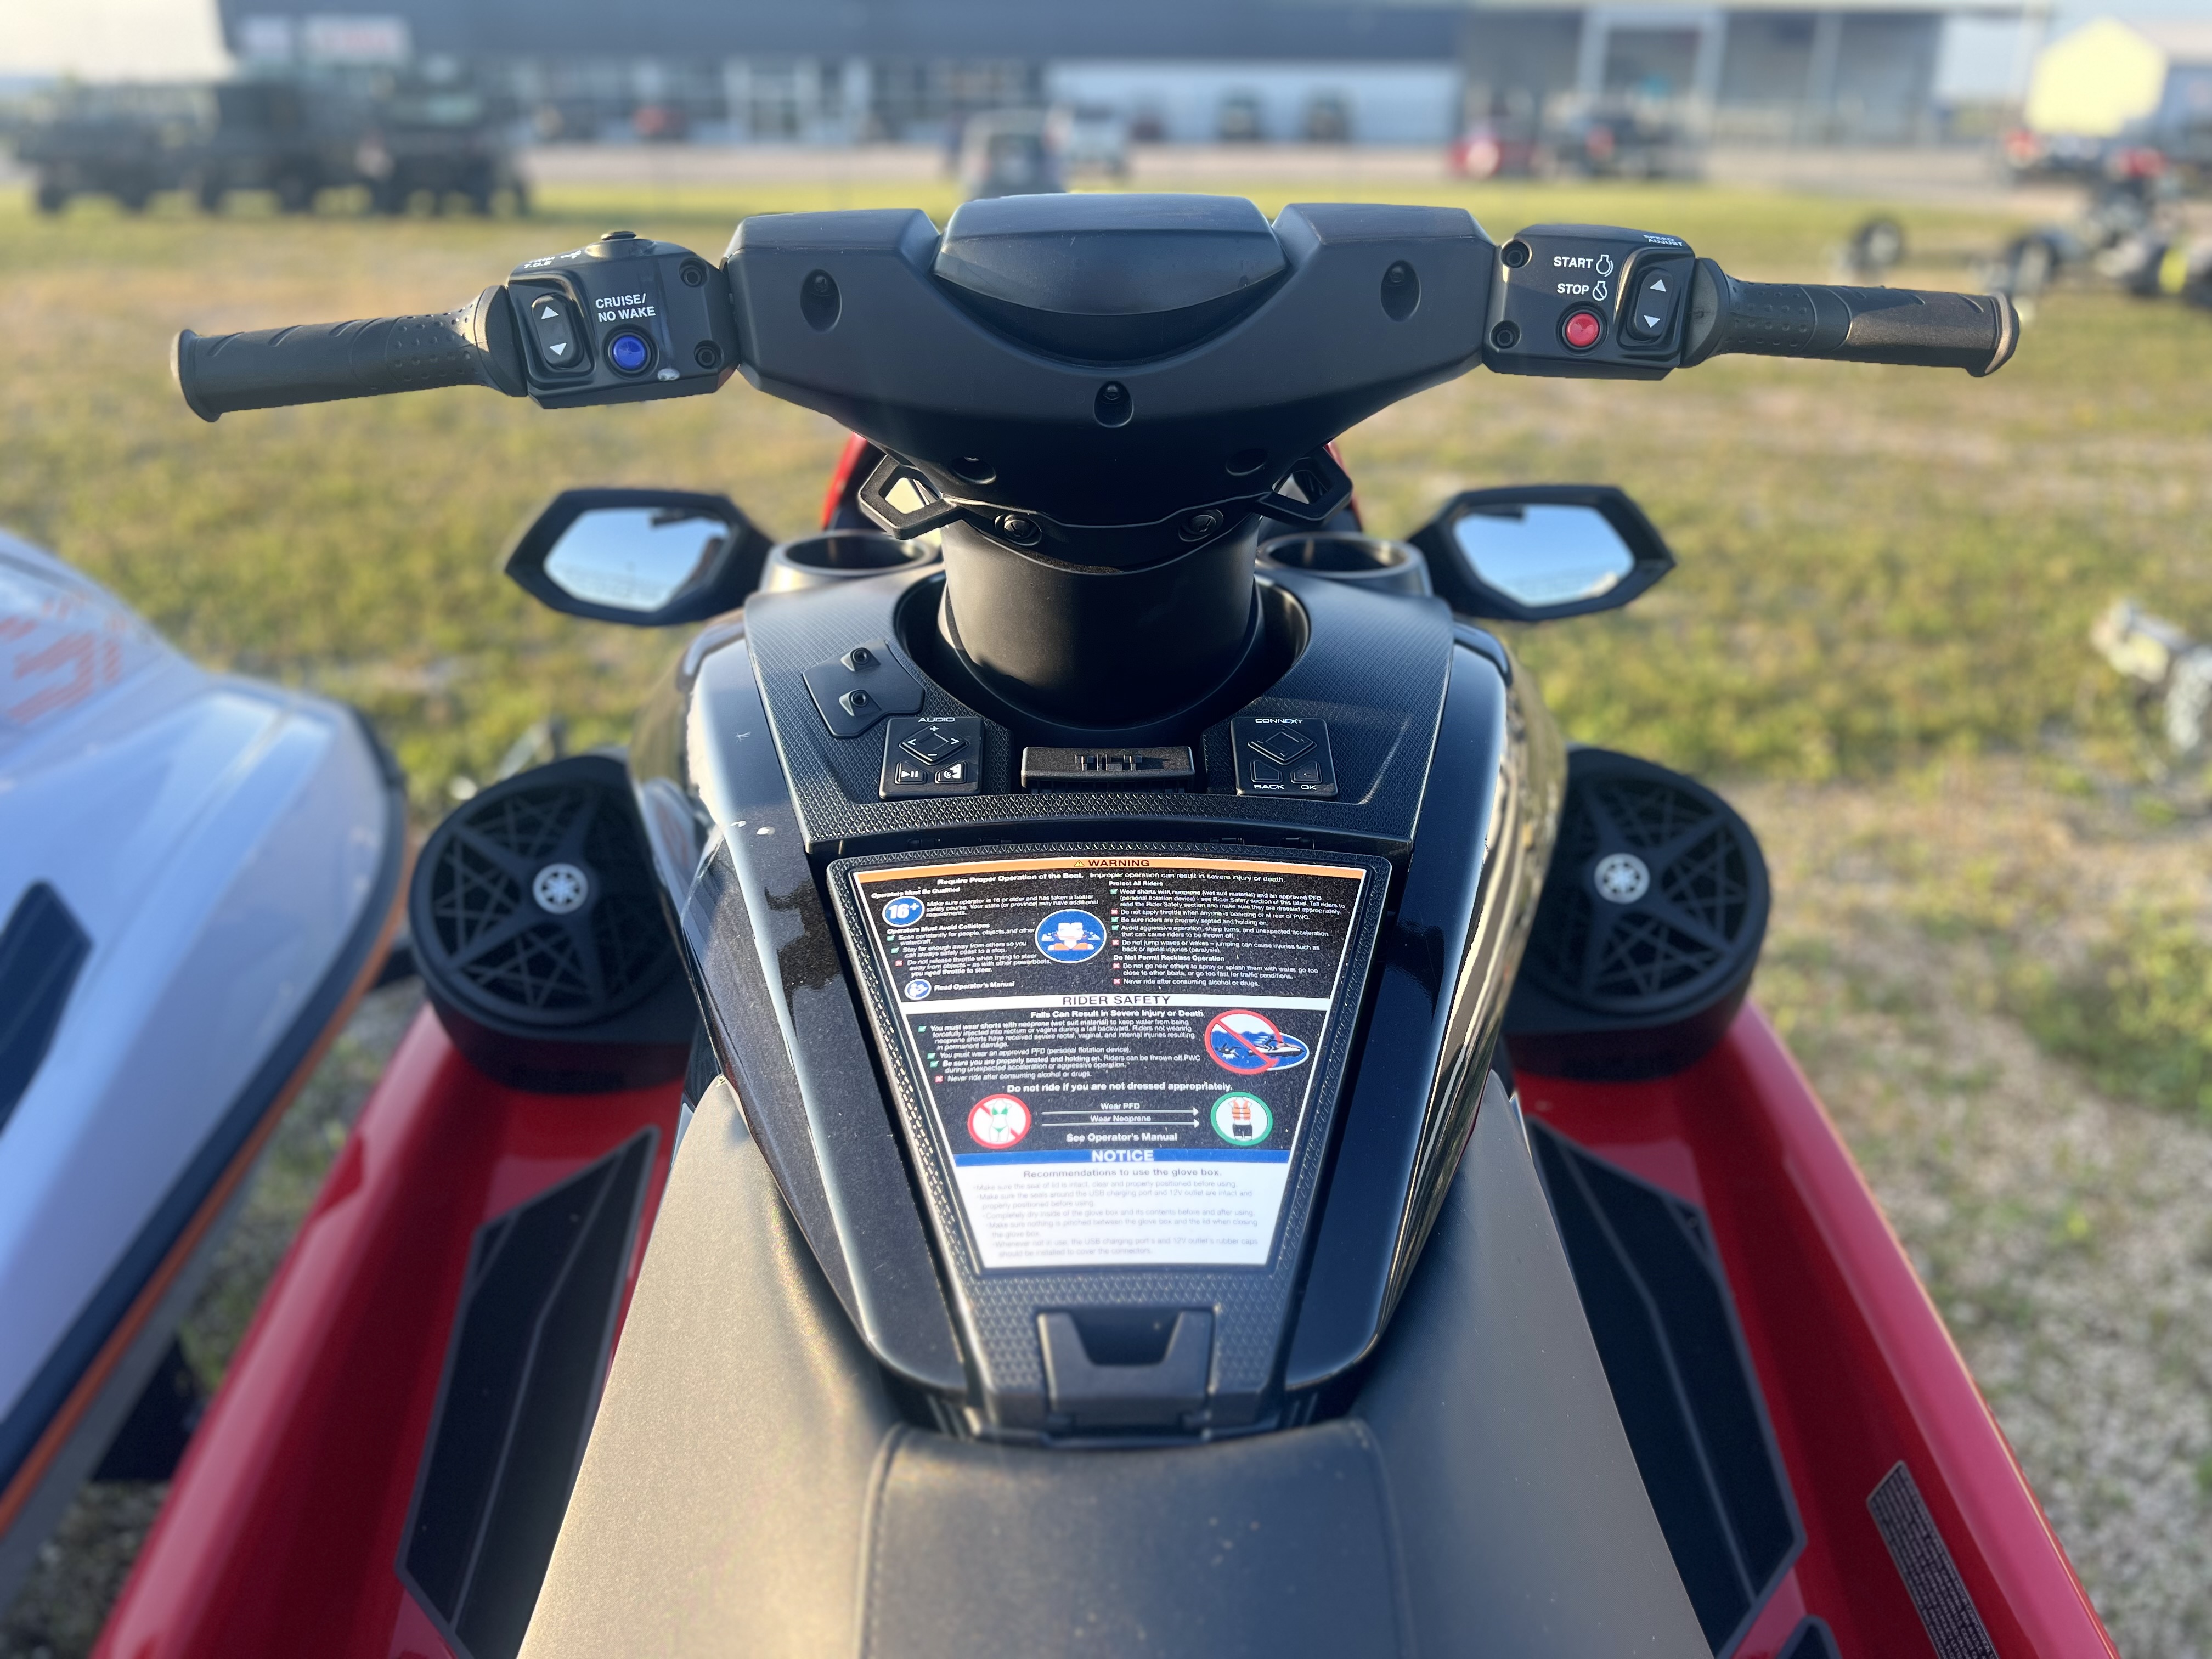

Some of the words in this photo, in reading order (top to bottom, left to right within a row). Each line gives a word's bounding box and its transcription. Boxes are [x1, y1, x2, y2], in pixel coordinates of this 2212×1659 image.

[1648, 238, 1683, 246] ADJUST
[1553, 256, 1593, 269] START
[1556, 283, 1589, 296] STOP
[596, 292, 646, 308] CRUISE/
[598, 311, 616, 323] NO
[618, 306, 656, 320] WAKE
[1088, 859, 1150, 867] WARNING
[937, 877, 968, 886] Require
[969, 876, 996, 884] Proper
[998, 874, 1036, 883] Operation
[871, 891, 903, 900] Operators
[888, 903, 919, 919] 16+
[887, 927, 919, 935] Operators
[953, 982, 988, 990] Operator's
[1063, 996, 1108, 1005] RIDER
[1114, 996, 1170, 1005] SAFETY
[1141, 1009, 1165, 1018] Injury
[998, 1048, 1029, 1057] approved
[1000, 1072, 1035, 1081] consuming
[1167, 1082, 1233, 1091] appropriately.
[1066, 1133, 1085, 1142] See
[1087, 1133, 1139, 1143] Operator's
[1141, 1133, 1177, 1141] Manual
[1092, 1150, 1154, 1162] NOTICE
[1024, 1169, 1116, 1177] Recommendations
[1960, 1627, 1973, 1650] COAST
